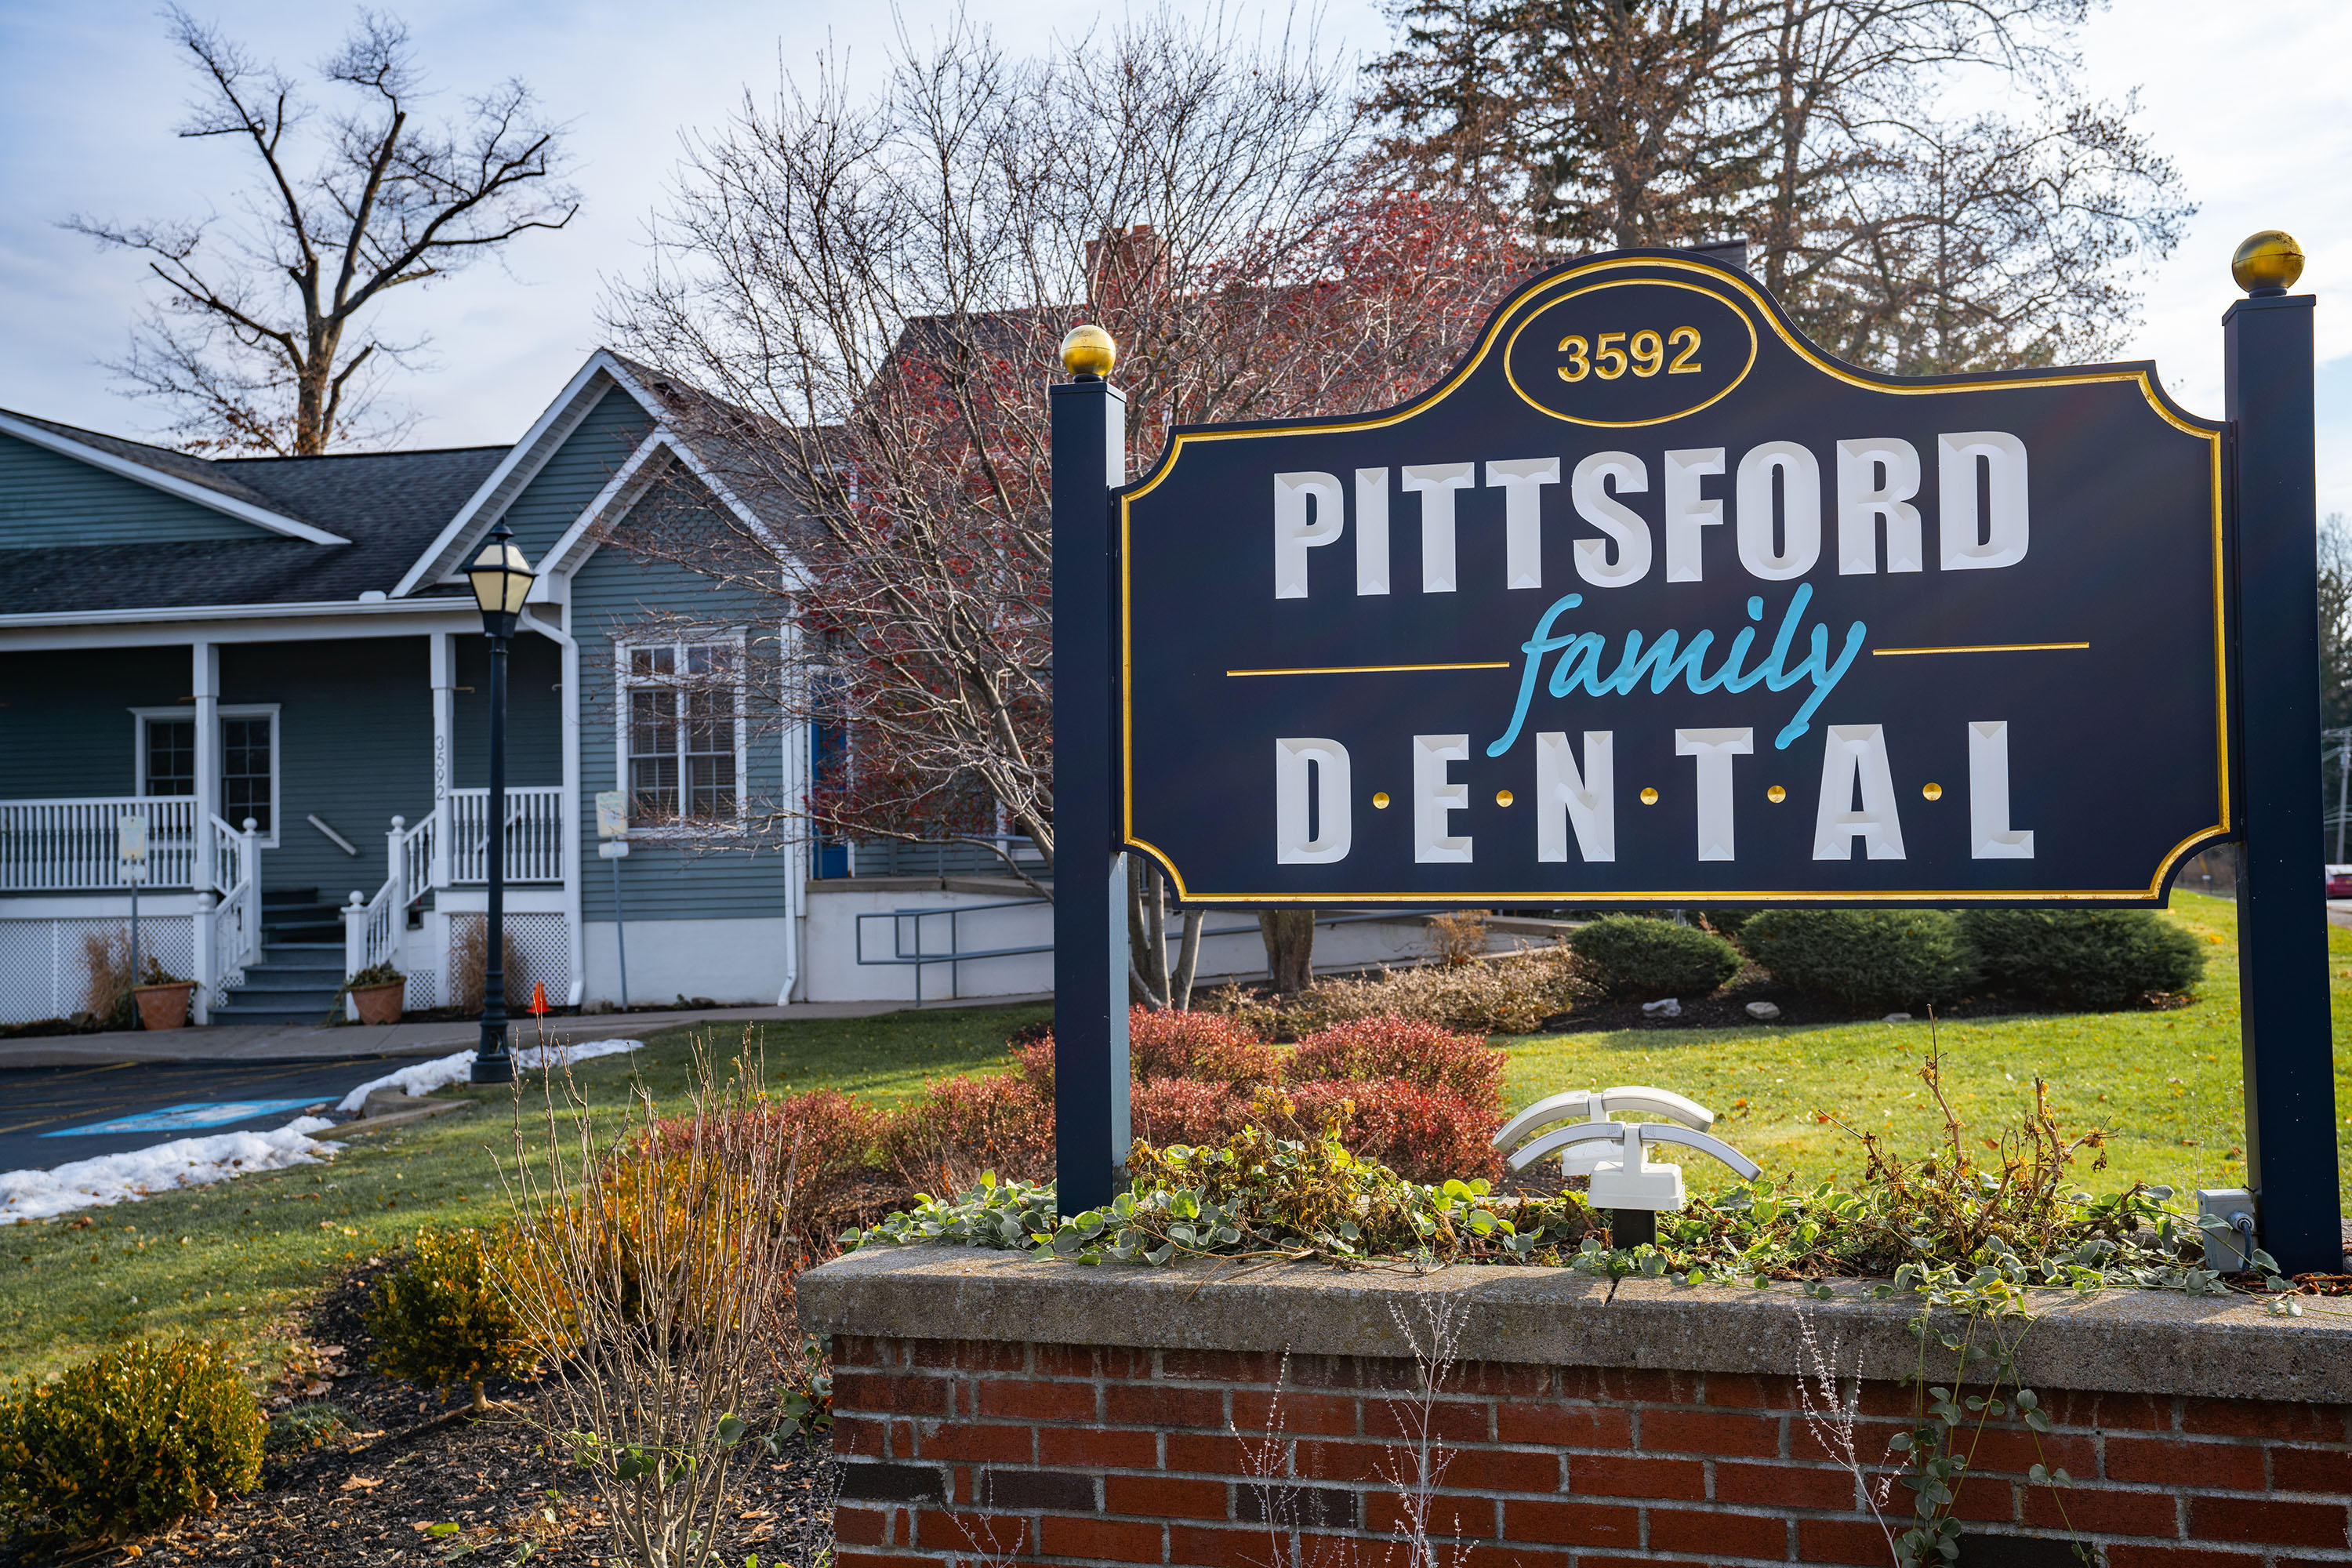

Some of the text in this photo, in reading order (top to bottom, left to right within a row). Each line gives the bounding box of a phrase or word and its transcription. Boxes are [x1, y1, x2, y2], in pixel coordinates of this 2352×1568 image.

[1557, 325, 1702, 383] 3592
[1273, 430, 2030, 600] PITTSFORD
[1486, 582, 1867, 758] family
[437, 735, 445, 800] 3592
